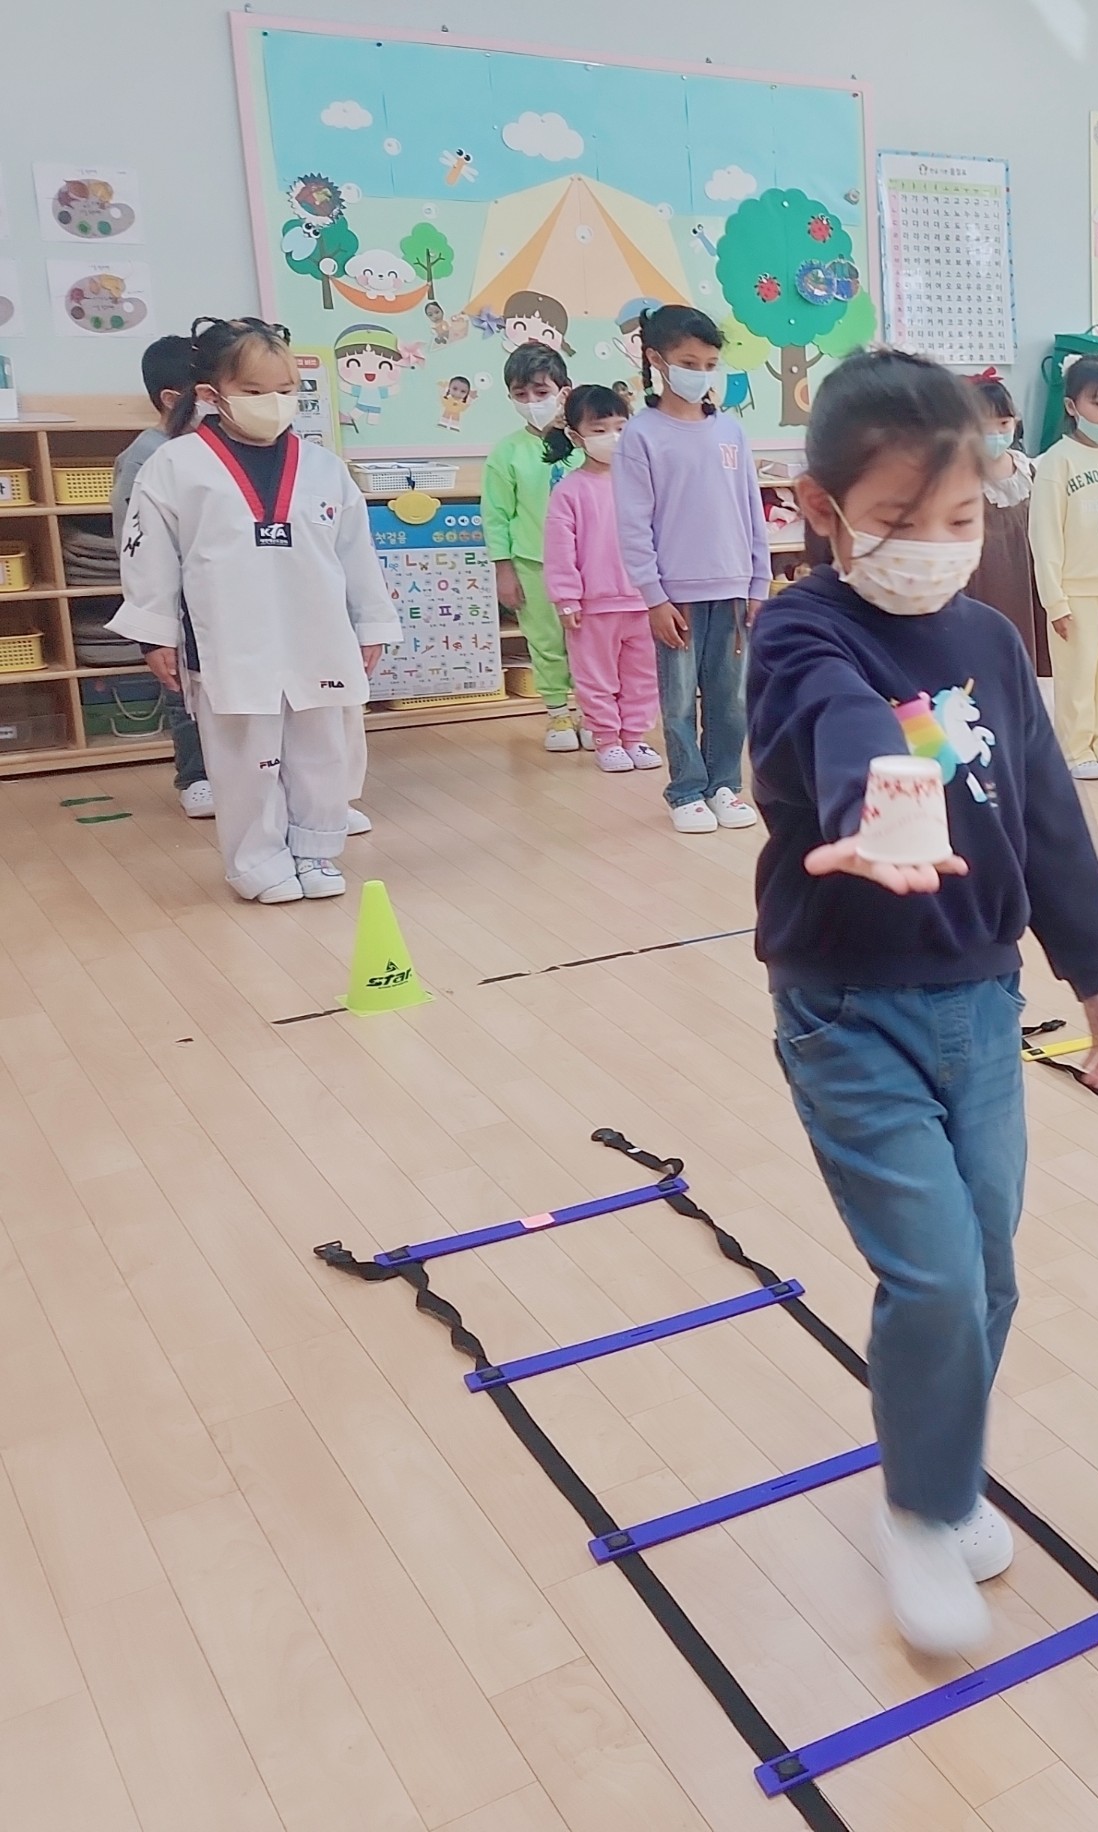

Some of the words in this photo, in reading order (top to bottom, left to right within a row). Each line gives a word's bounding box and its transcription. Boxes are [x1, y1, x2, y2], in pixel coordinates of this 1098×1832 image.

[718, 444, 738, 470] N
[260, 523, 287, 539] KTA
[376, 530, 407, 544] 첫걸음
[436, 554, 447, 565] ㄷ
[465, 552, 476, 565] ㄹ
[408, 581, 421, 593] ㅅ
[467, 579, 479, 589] ㅈ
[410, 607, 421, 619] ㅌ
[439, 606, 452, 616] ㅍ
[468, 604, 480, 616] ㅎ
[320, 680, 344, 688] FILA
[260, 758, 280, 770] FILA
